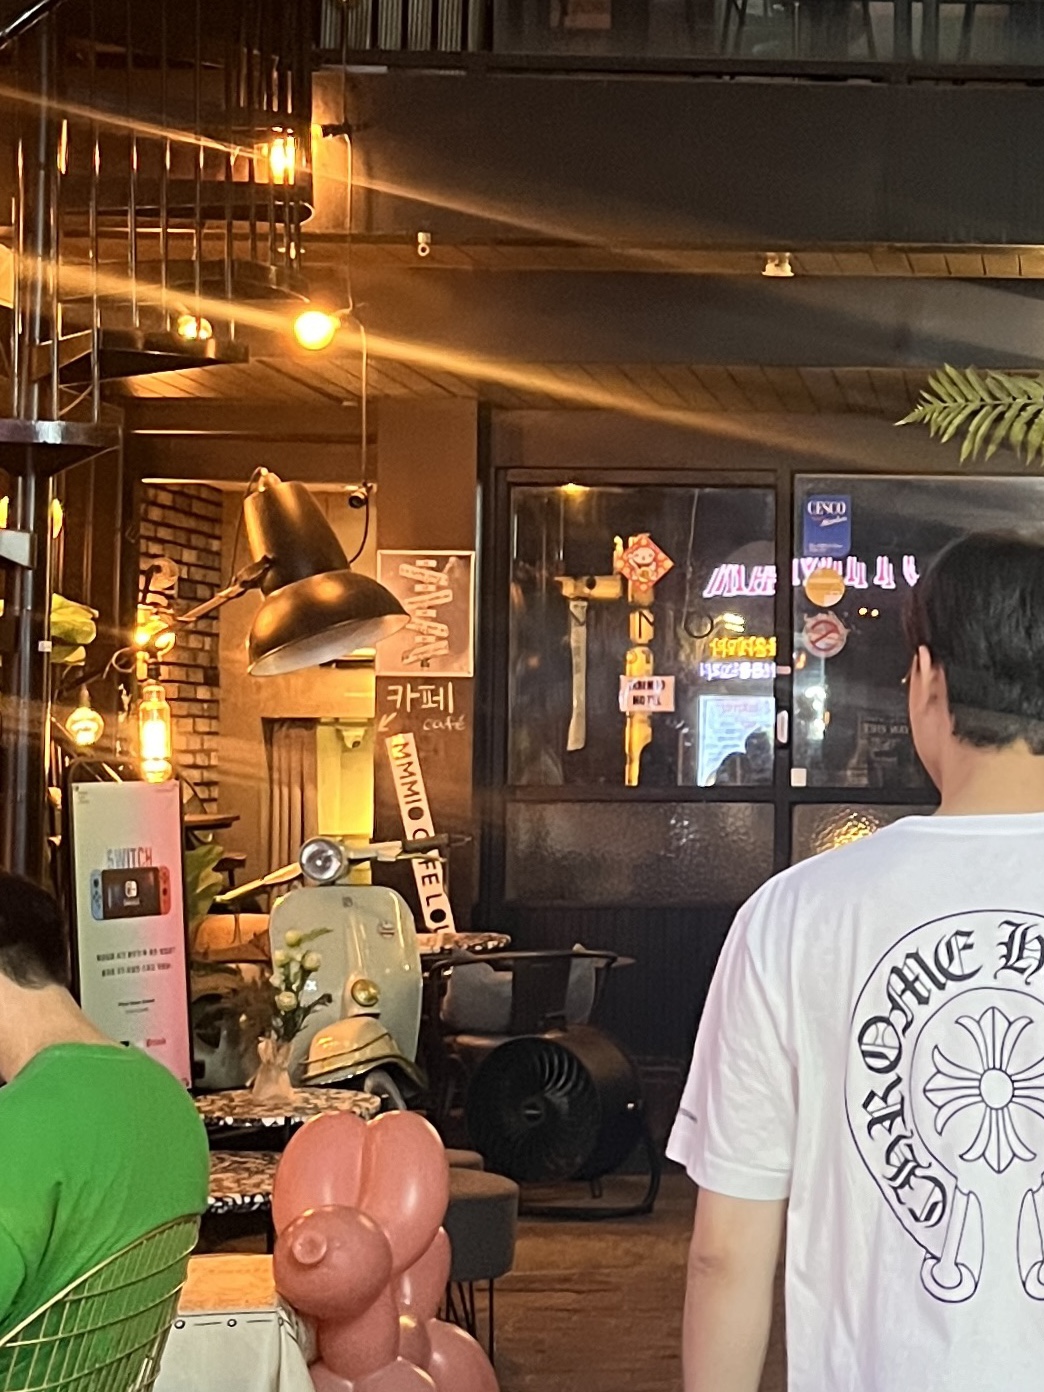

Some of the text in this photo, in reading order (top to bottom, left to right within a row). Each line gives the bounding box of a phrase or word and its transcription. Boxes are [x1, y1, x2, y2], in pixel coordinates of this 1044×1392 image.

[807, 500, 846, 515] CESCO
[387, 682, 454, 713] 카페
[422, 713, 467, 731] café
[107, 847, 152, 868] SWITCH
[412, 827, 441, 886] CFE
[857, 929, 983, 1229] CHROME
